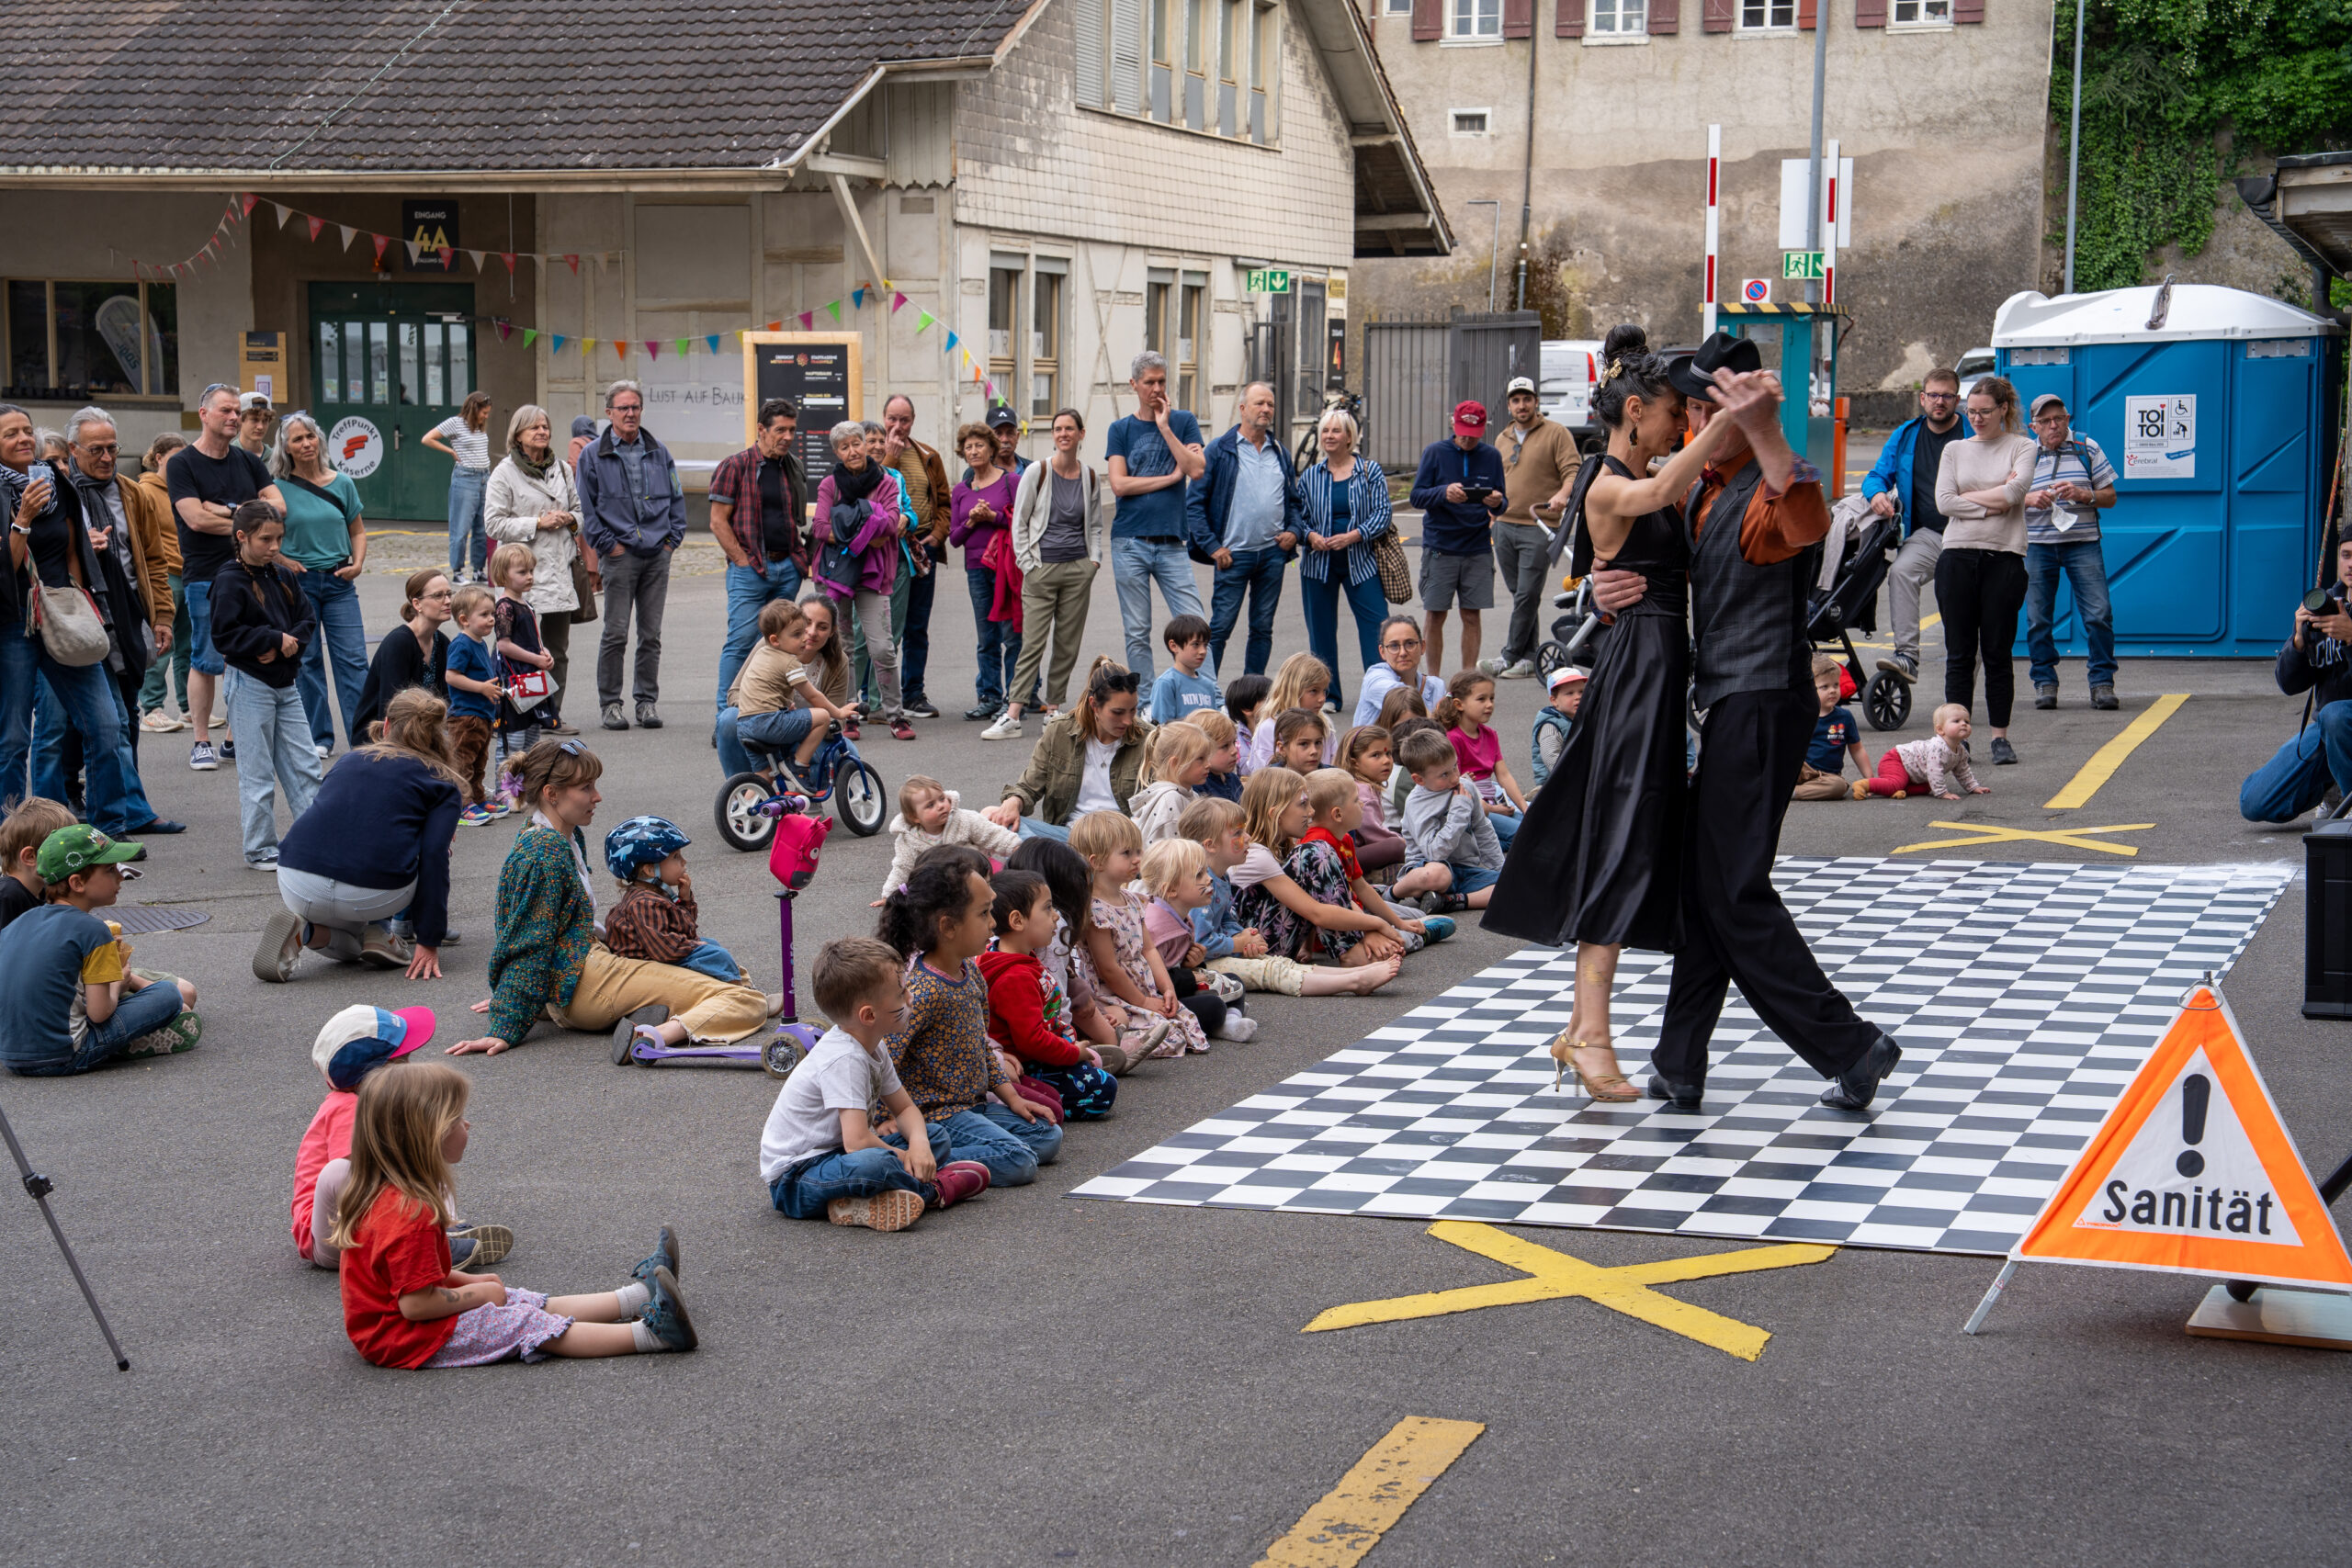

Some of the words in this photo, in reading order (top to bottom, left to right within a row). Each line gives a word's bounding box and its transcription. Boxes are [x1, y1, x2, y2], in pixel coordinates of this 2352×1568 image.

[414, 211, 447, 220] EINGANG
[413, 225, 450, 253] 4A
[650, 387, 677, 403] LUST
[684, 389, 708, 404] AUF
[2138, 408, 2165, 423] TOI
[2137, 423, 2165, 438] TOI
[337, 460, 376, 477] Kaserne
[2103, 1179, 2273, 1235] Sanität
